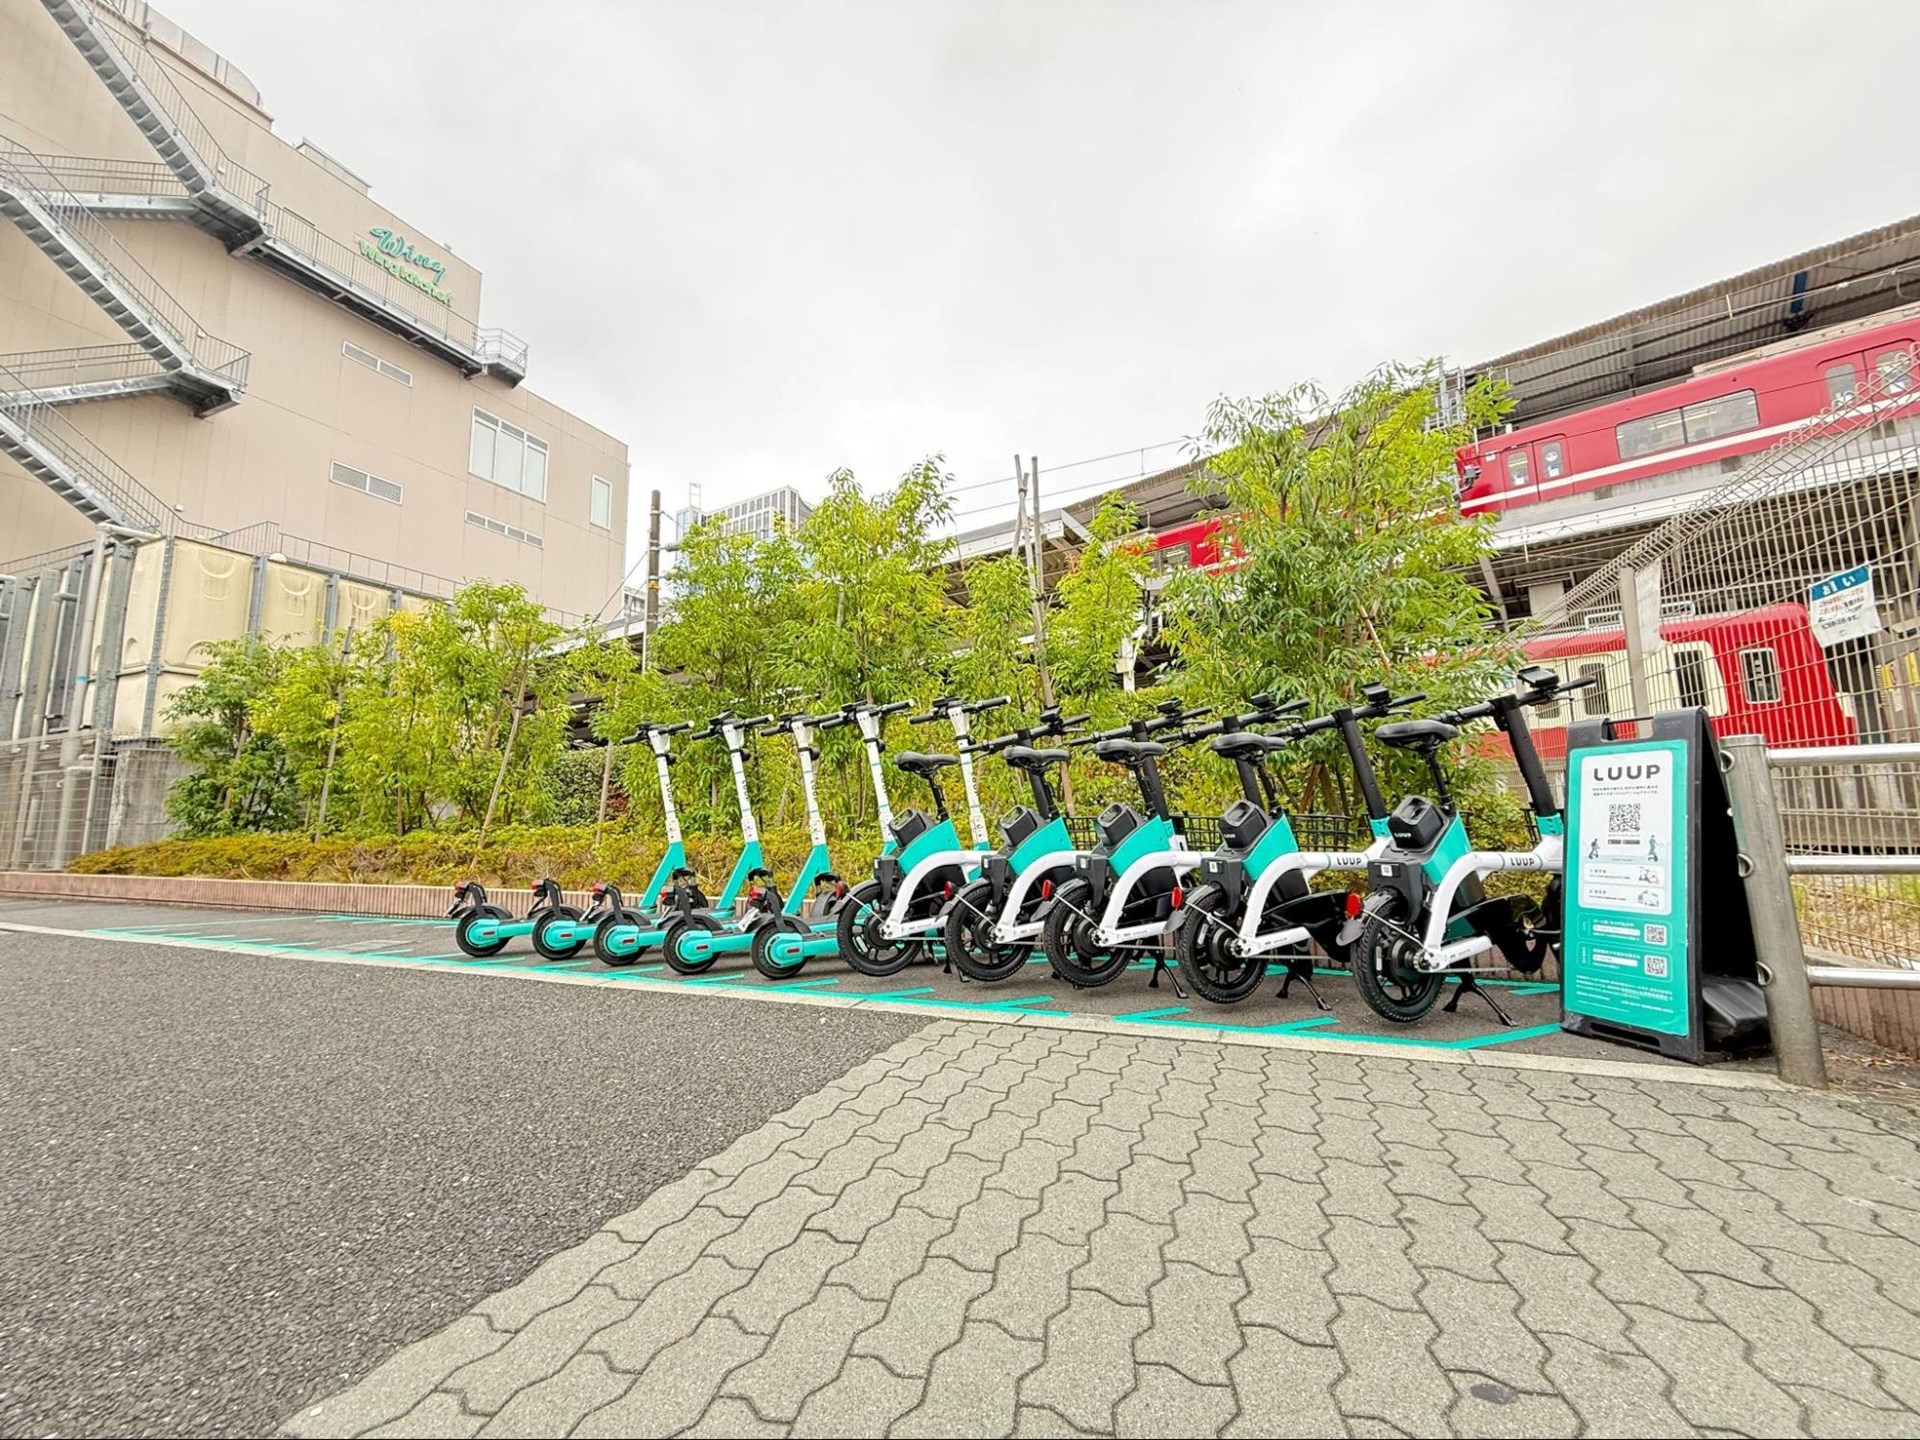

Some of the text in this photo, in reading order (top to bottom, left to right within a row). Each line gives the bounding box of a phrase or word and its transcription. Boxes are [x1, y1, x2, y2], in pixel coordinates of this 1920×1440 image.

[369, 227, 446, 286] Wing
[1593, 764, 1661, 781] LUUP
[1336, 856, 1362, 866] LUUP
[1509, 857, 1535, 866] LUUP
